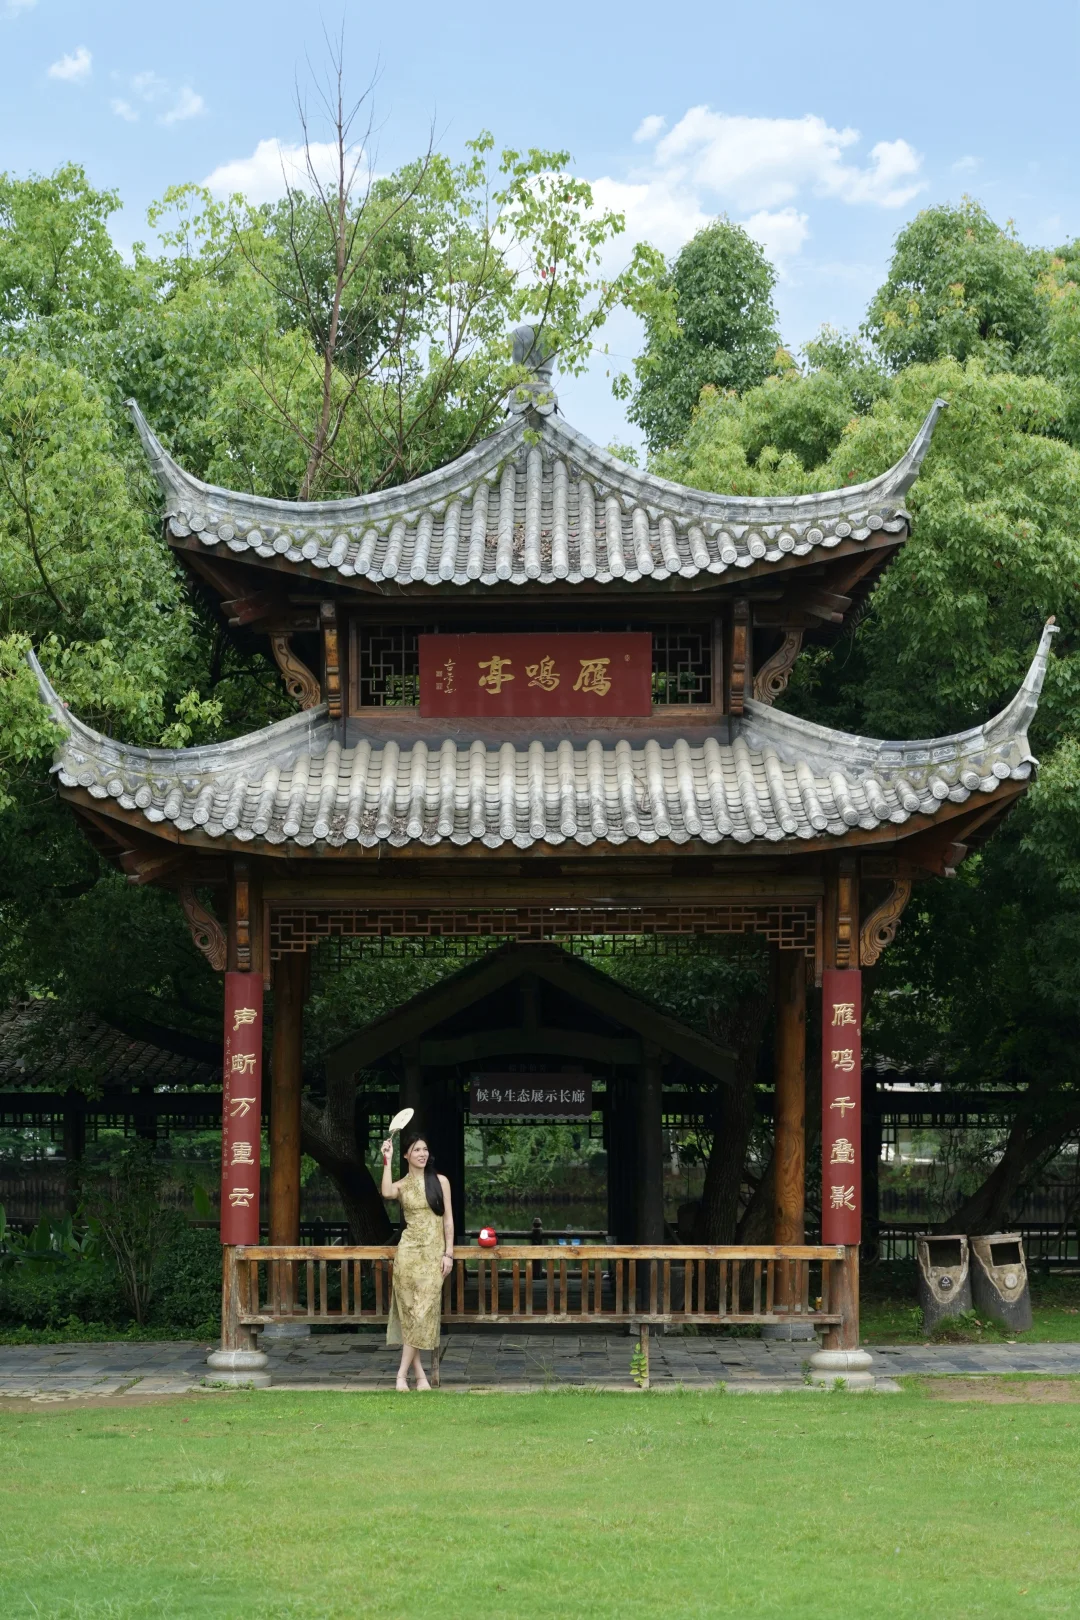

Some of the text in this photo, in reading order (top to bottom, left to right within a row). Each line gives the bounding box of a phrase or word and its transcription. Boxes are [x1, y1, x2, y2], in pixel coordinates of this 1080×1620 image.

[229, 1007, 257, 1207] 声断万重云
[476, 1088, 586, 1104] 候鸟生态展示长廊
[830, 1003, 856, 1211] 雁鸣千叠影
